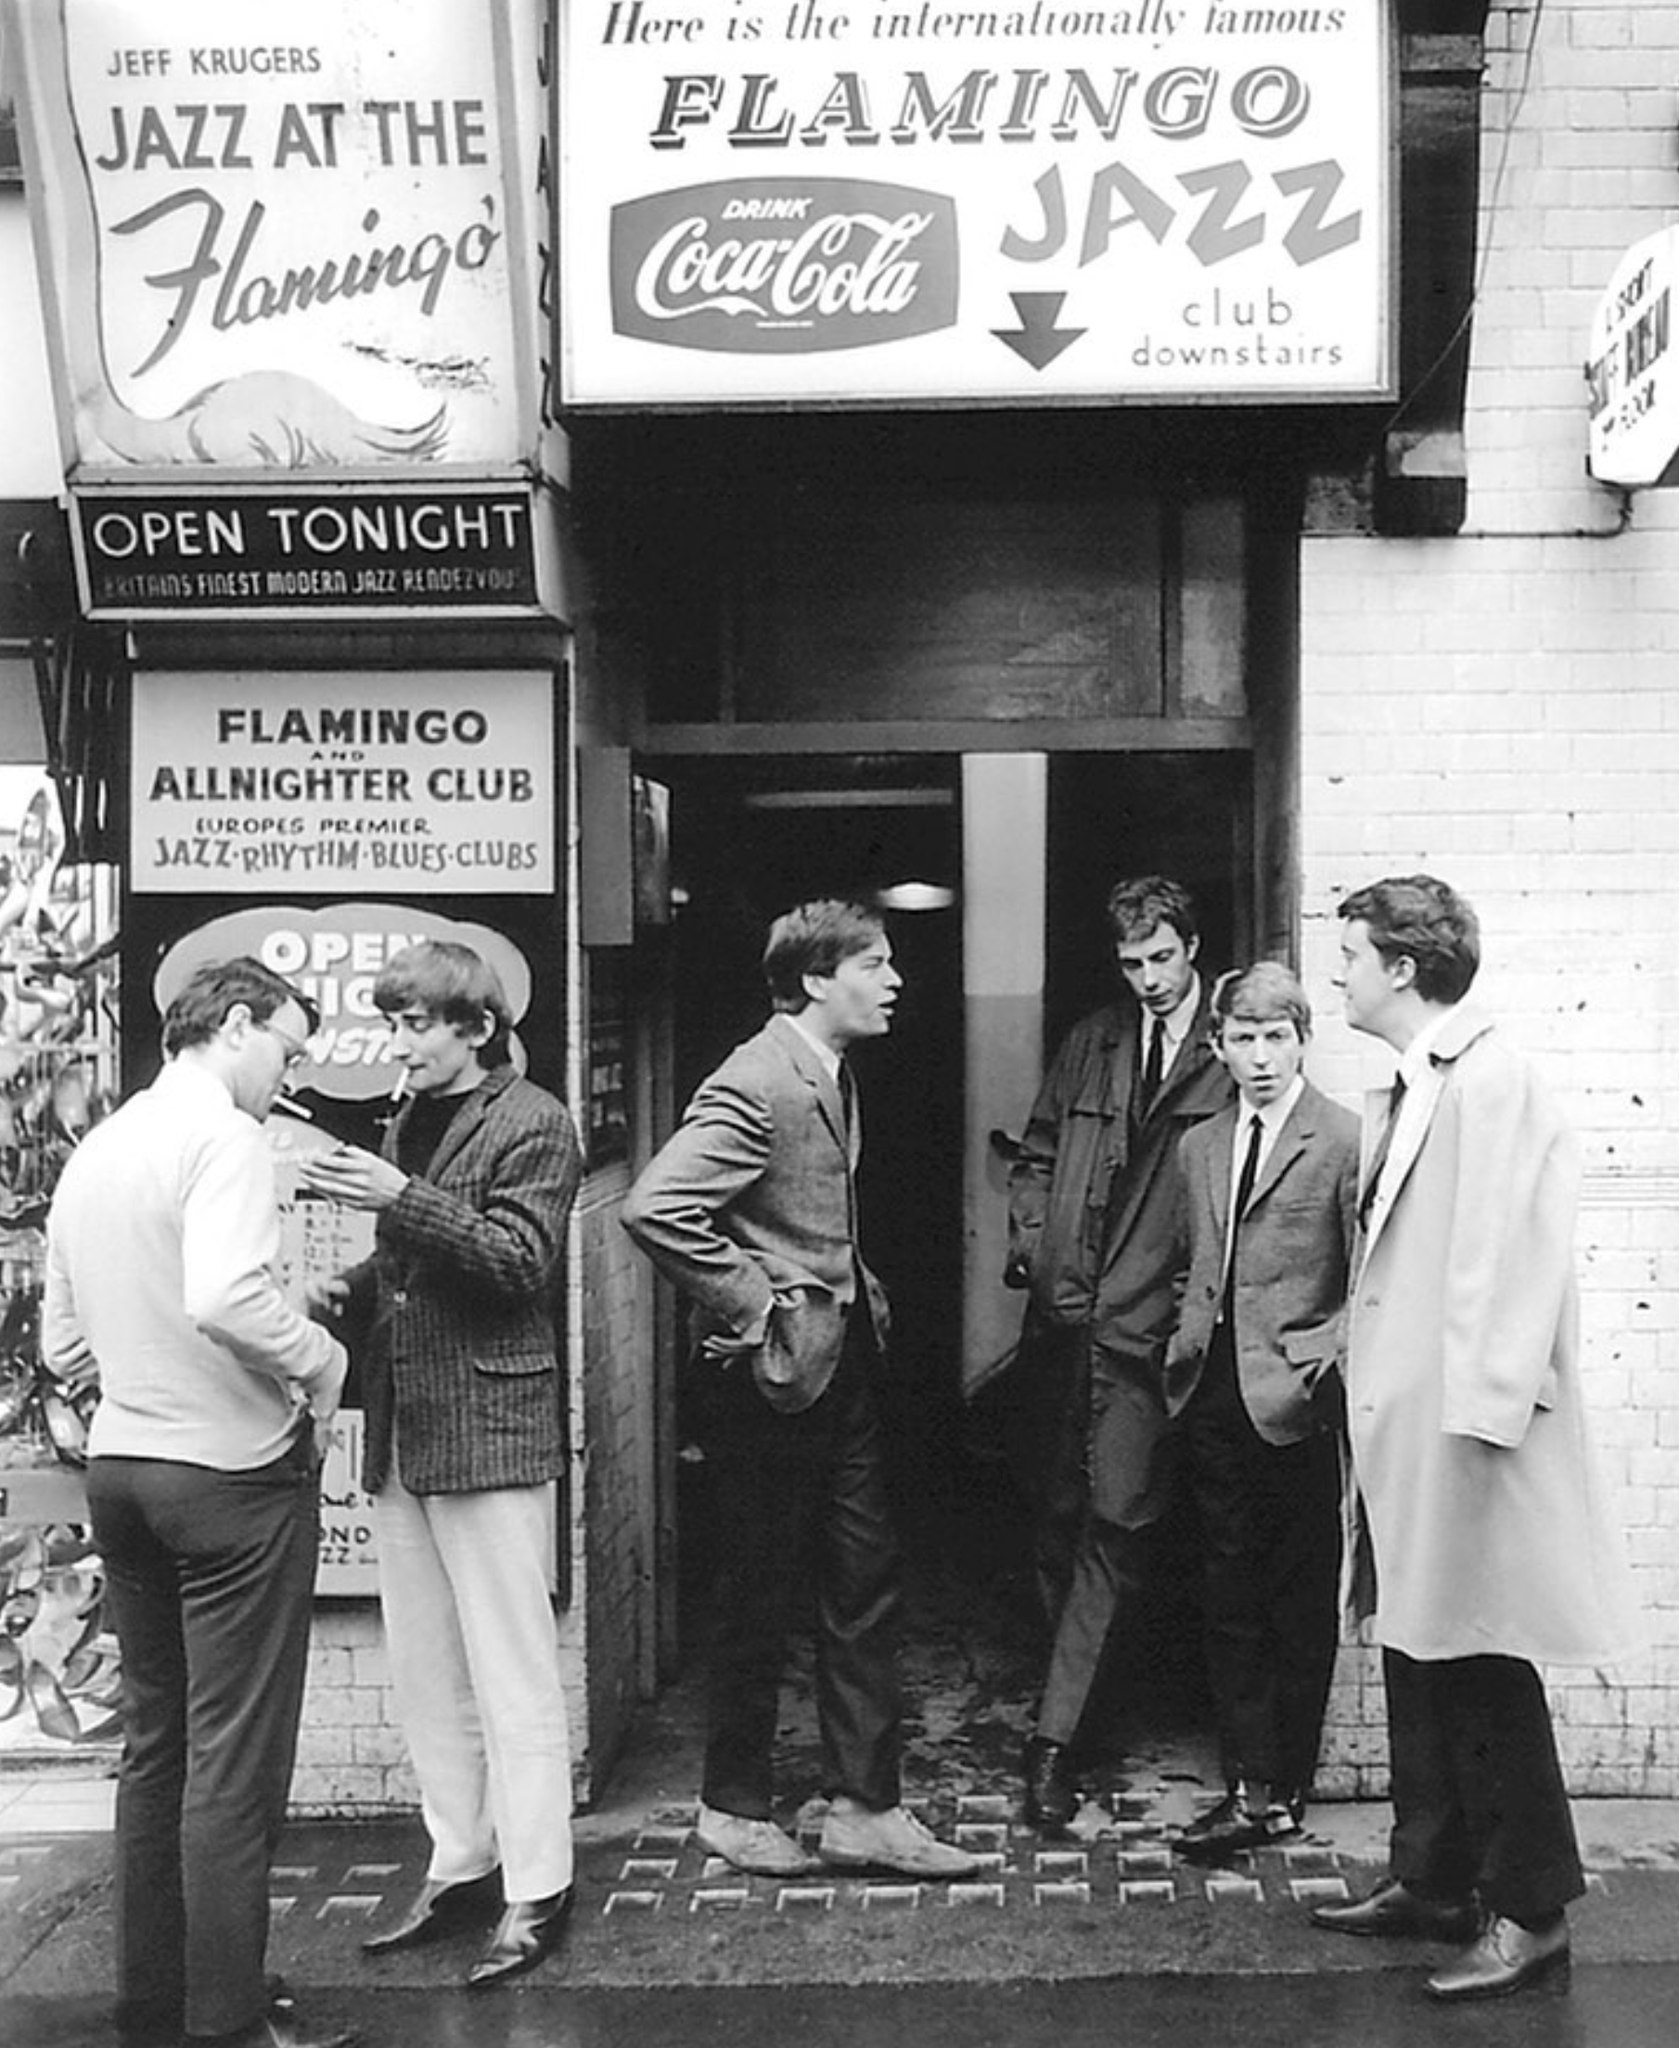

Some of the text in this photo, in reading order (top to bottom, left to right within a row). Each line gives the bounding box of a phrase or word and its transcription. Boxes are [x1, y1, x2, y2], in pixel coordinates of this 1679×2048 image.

[601, 0, 1346, 50] Here is the internationally famous
[107, 47, 322, 77] JEFF KRUGERS
[650, 65, 1310, 149] FLAMINGO
[95, 100, 488, 171] JAZZ AT THE
[722, 199, 812, 220] DRINK
[1000, 159, 1362, 269] JAZZ
[108, 187, 502, 378] Flamingo
[635, 211, 935, 319] Coca-Cola
[1183, 287, 1292, 327] club
[1131, 333, 1343, 366] downstairs
[94, 504, 525, 557] OPEN TONIGHT
[352, 569, 397, 594] JAZZ
[218, 709, 488, 744] FLAMINGO
[311, 750, 366, 762] AND
[149, 765, 535, 802] ALLNIGHTER CLUB
[195, 816, 433, 835] EUROPES PREMIER
